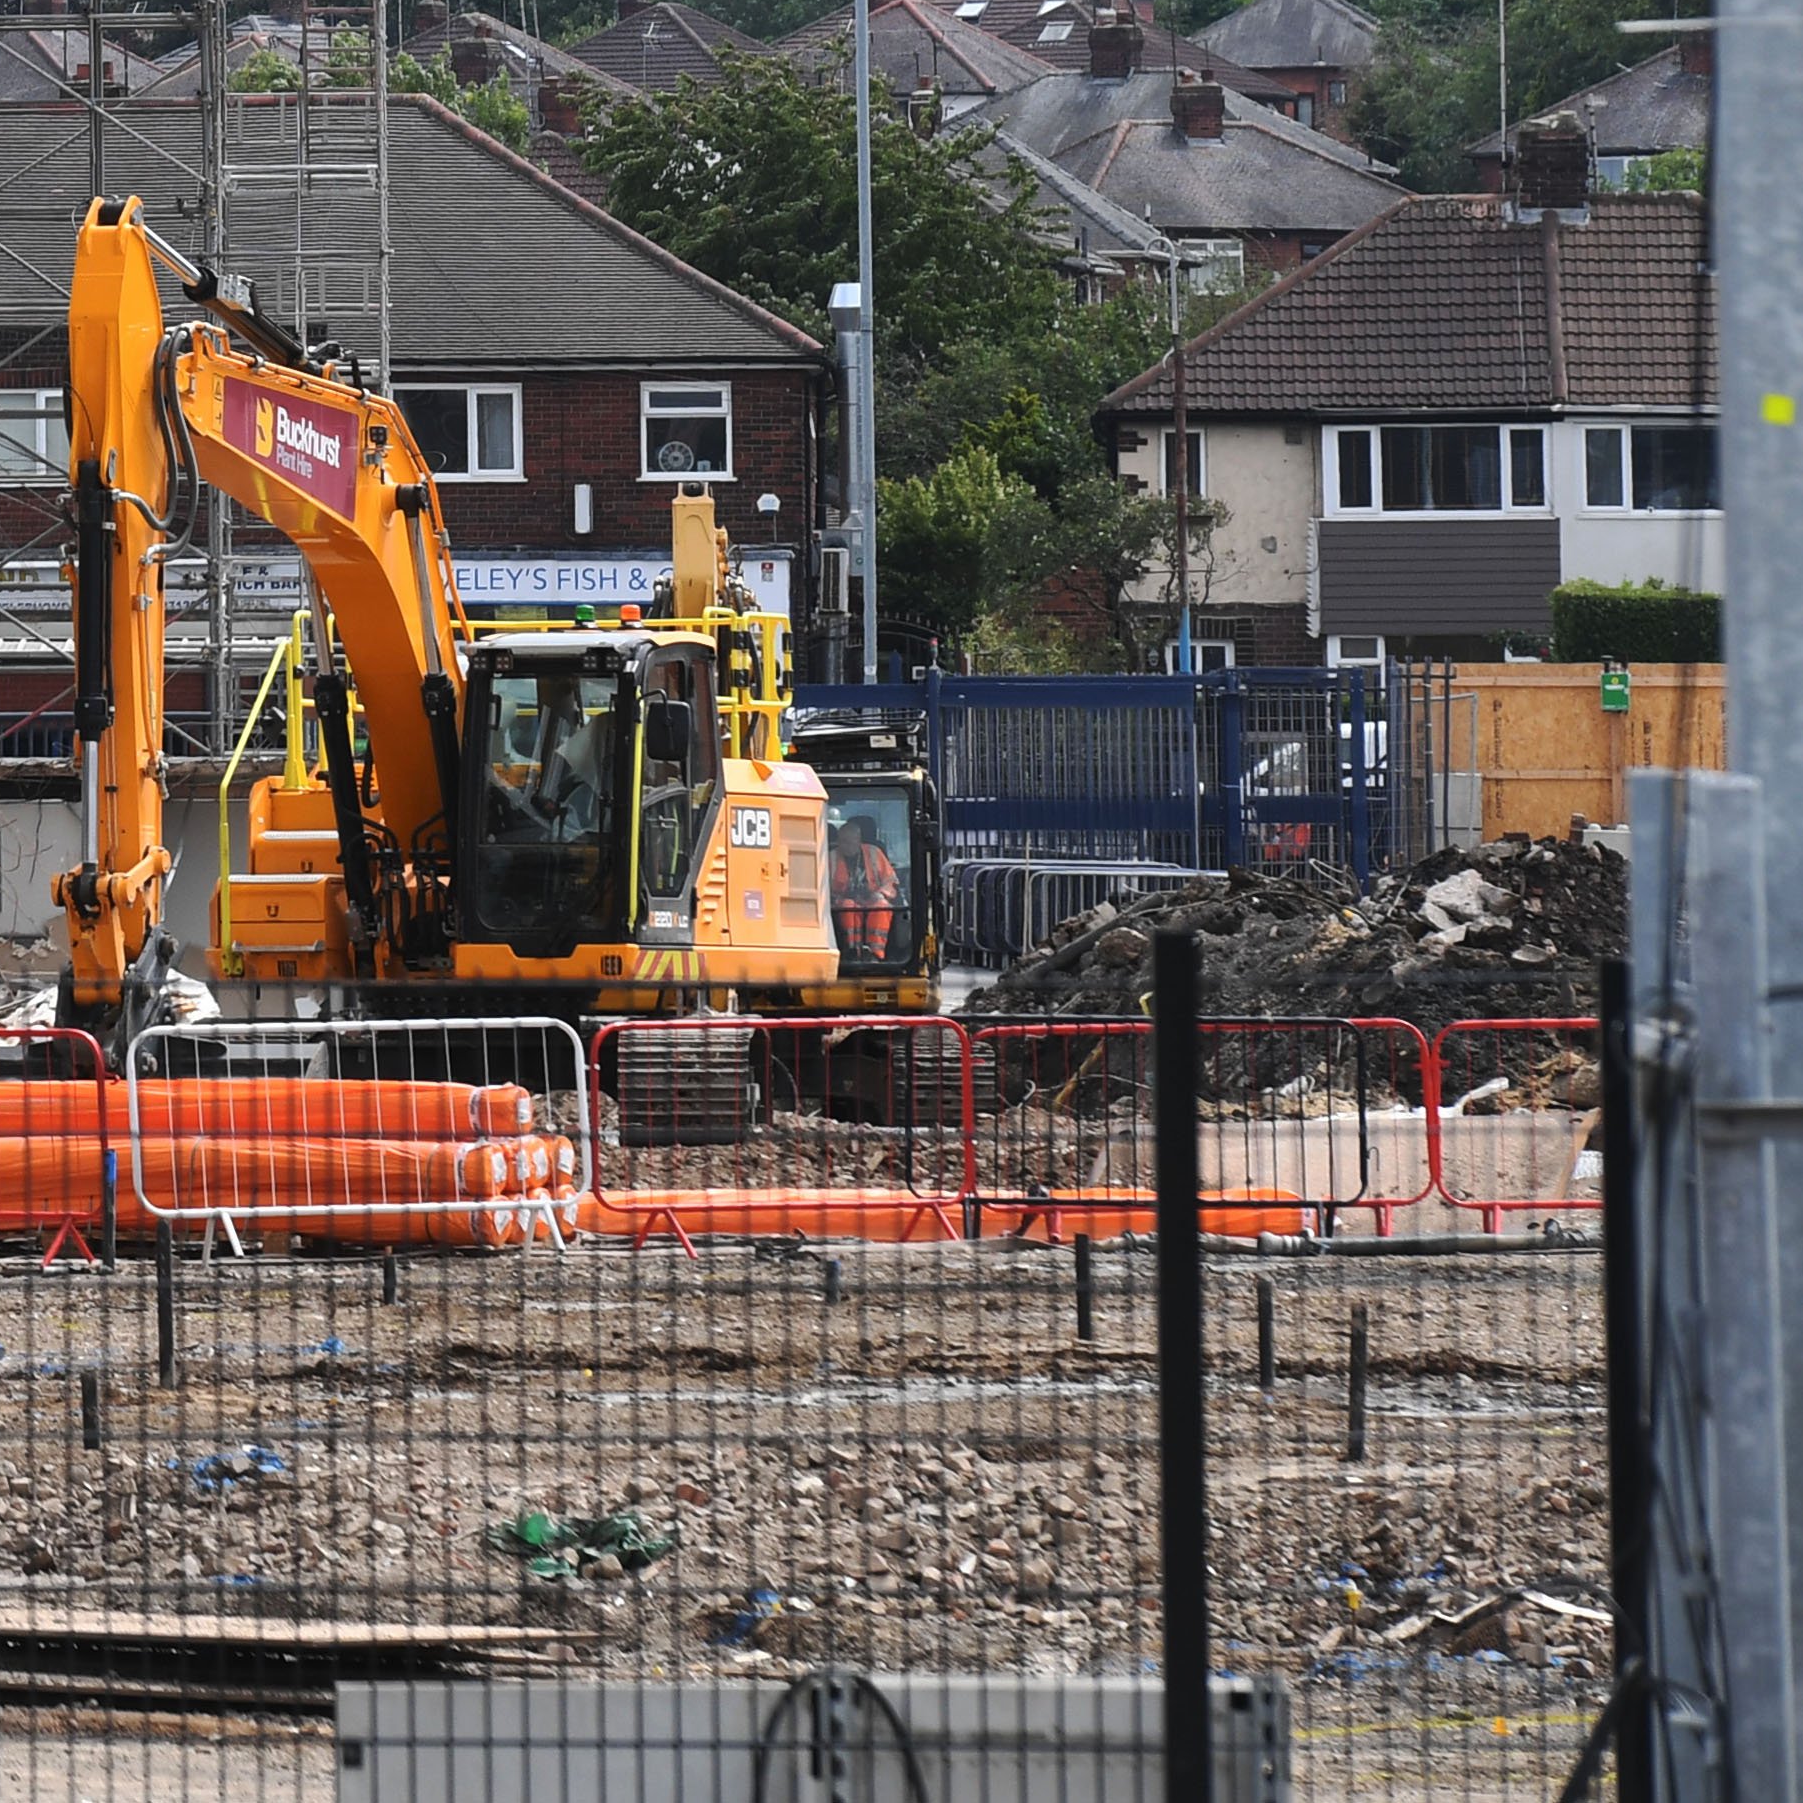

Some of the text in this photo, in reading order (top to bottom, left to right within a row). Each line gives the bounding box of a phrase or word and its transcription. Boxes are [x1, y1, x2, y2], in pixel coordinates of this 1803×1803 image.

[276, 406, 341, 469] Buckhurst
[276, 445, 313, 479] Plant Hire
[557, 567, 618, 590] FISH
[628, 567, 648, 590] &
[731, 809, 771, 846] JCB
